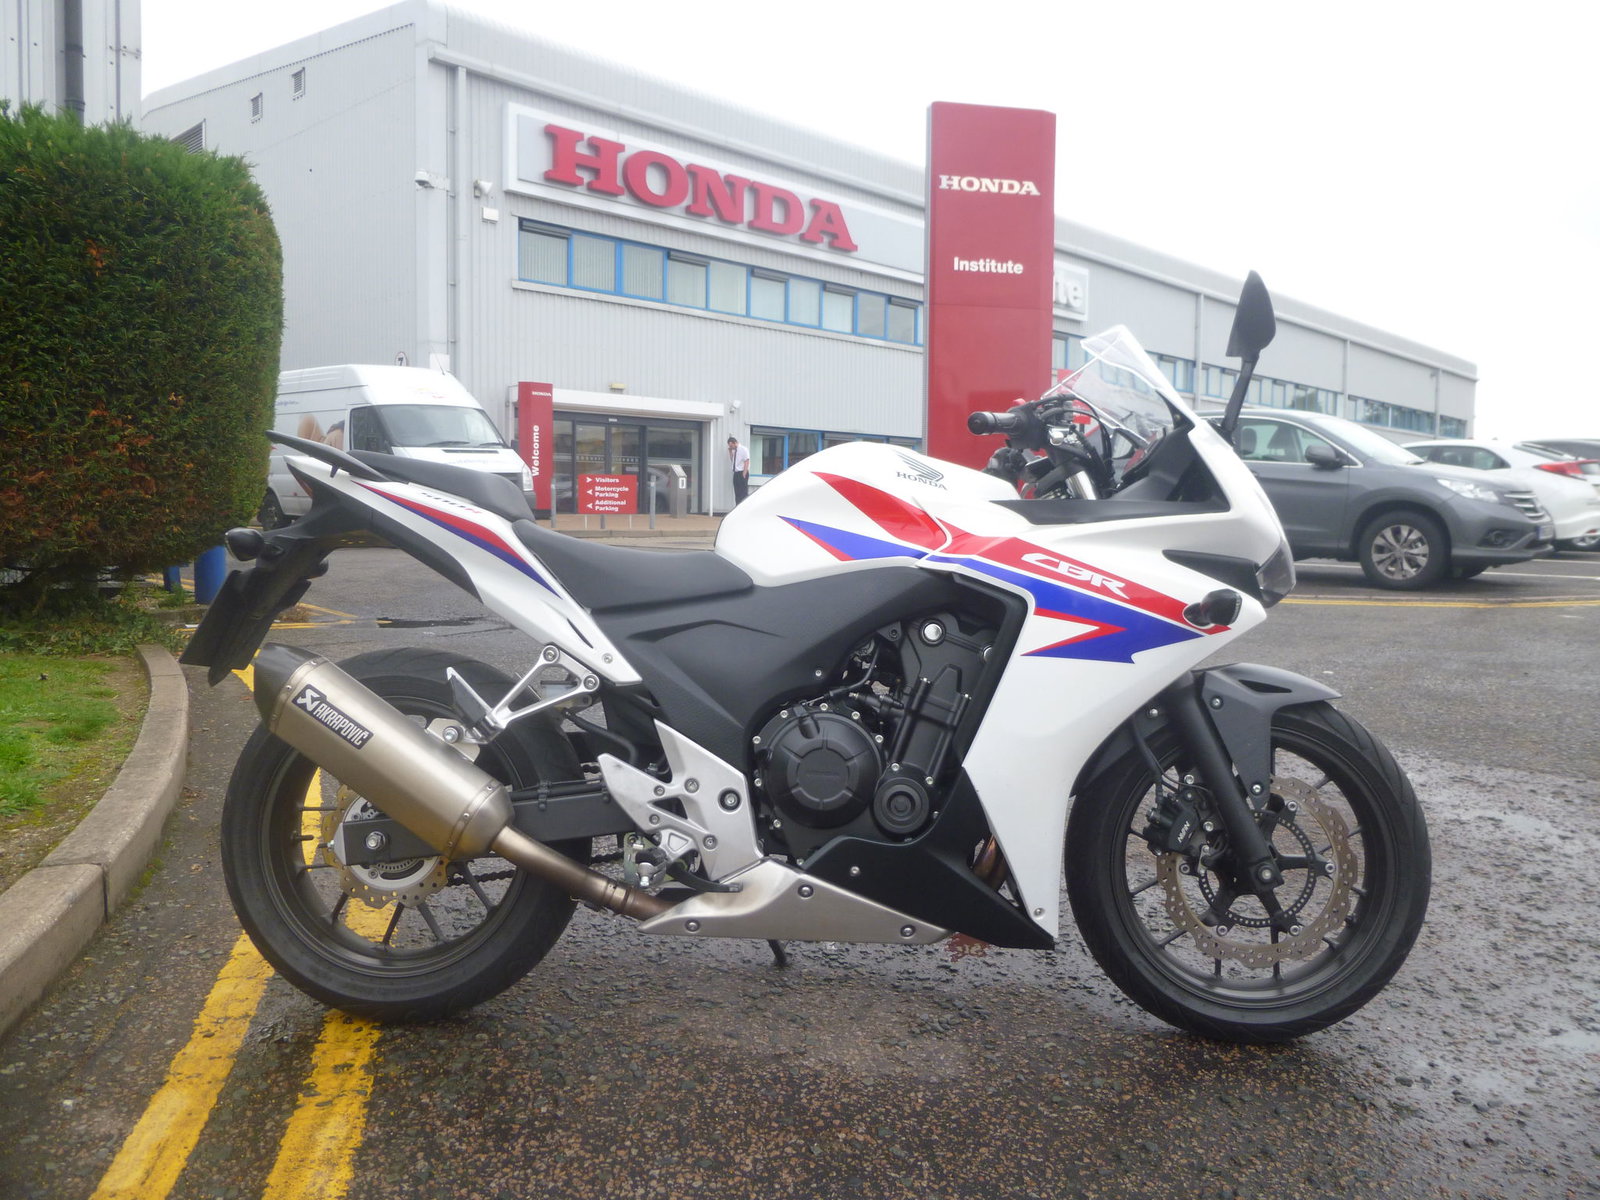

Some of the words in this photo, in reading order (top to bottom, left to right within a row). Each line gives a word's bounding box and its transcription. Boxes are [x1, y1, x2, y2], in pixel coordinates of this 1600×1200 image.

[544, 124, 858, 252] HONDA
[939, 174, 1040, 196] HONDA
[953, 256, 1024, 275] Institute
[1053, 276, 1083, 307] te
[532, 425, 540, 477] Welcome
[896, 471, 948, 490] HONDA
[1021, 552, 1130, 599] CBR
